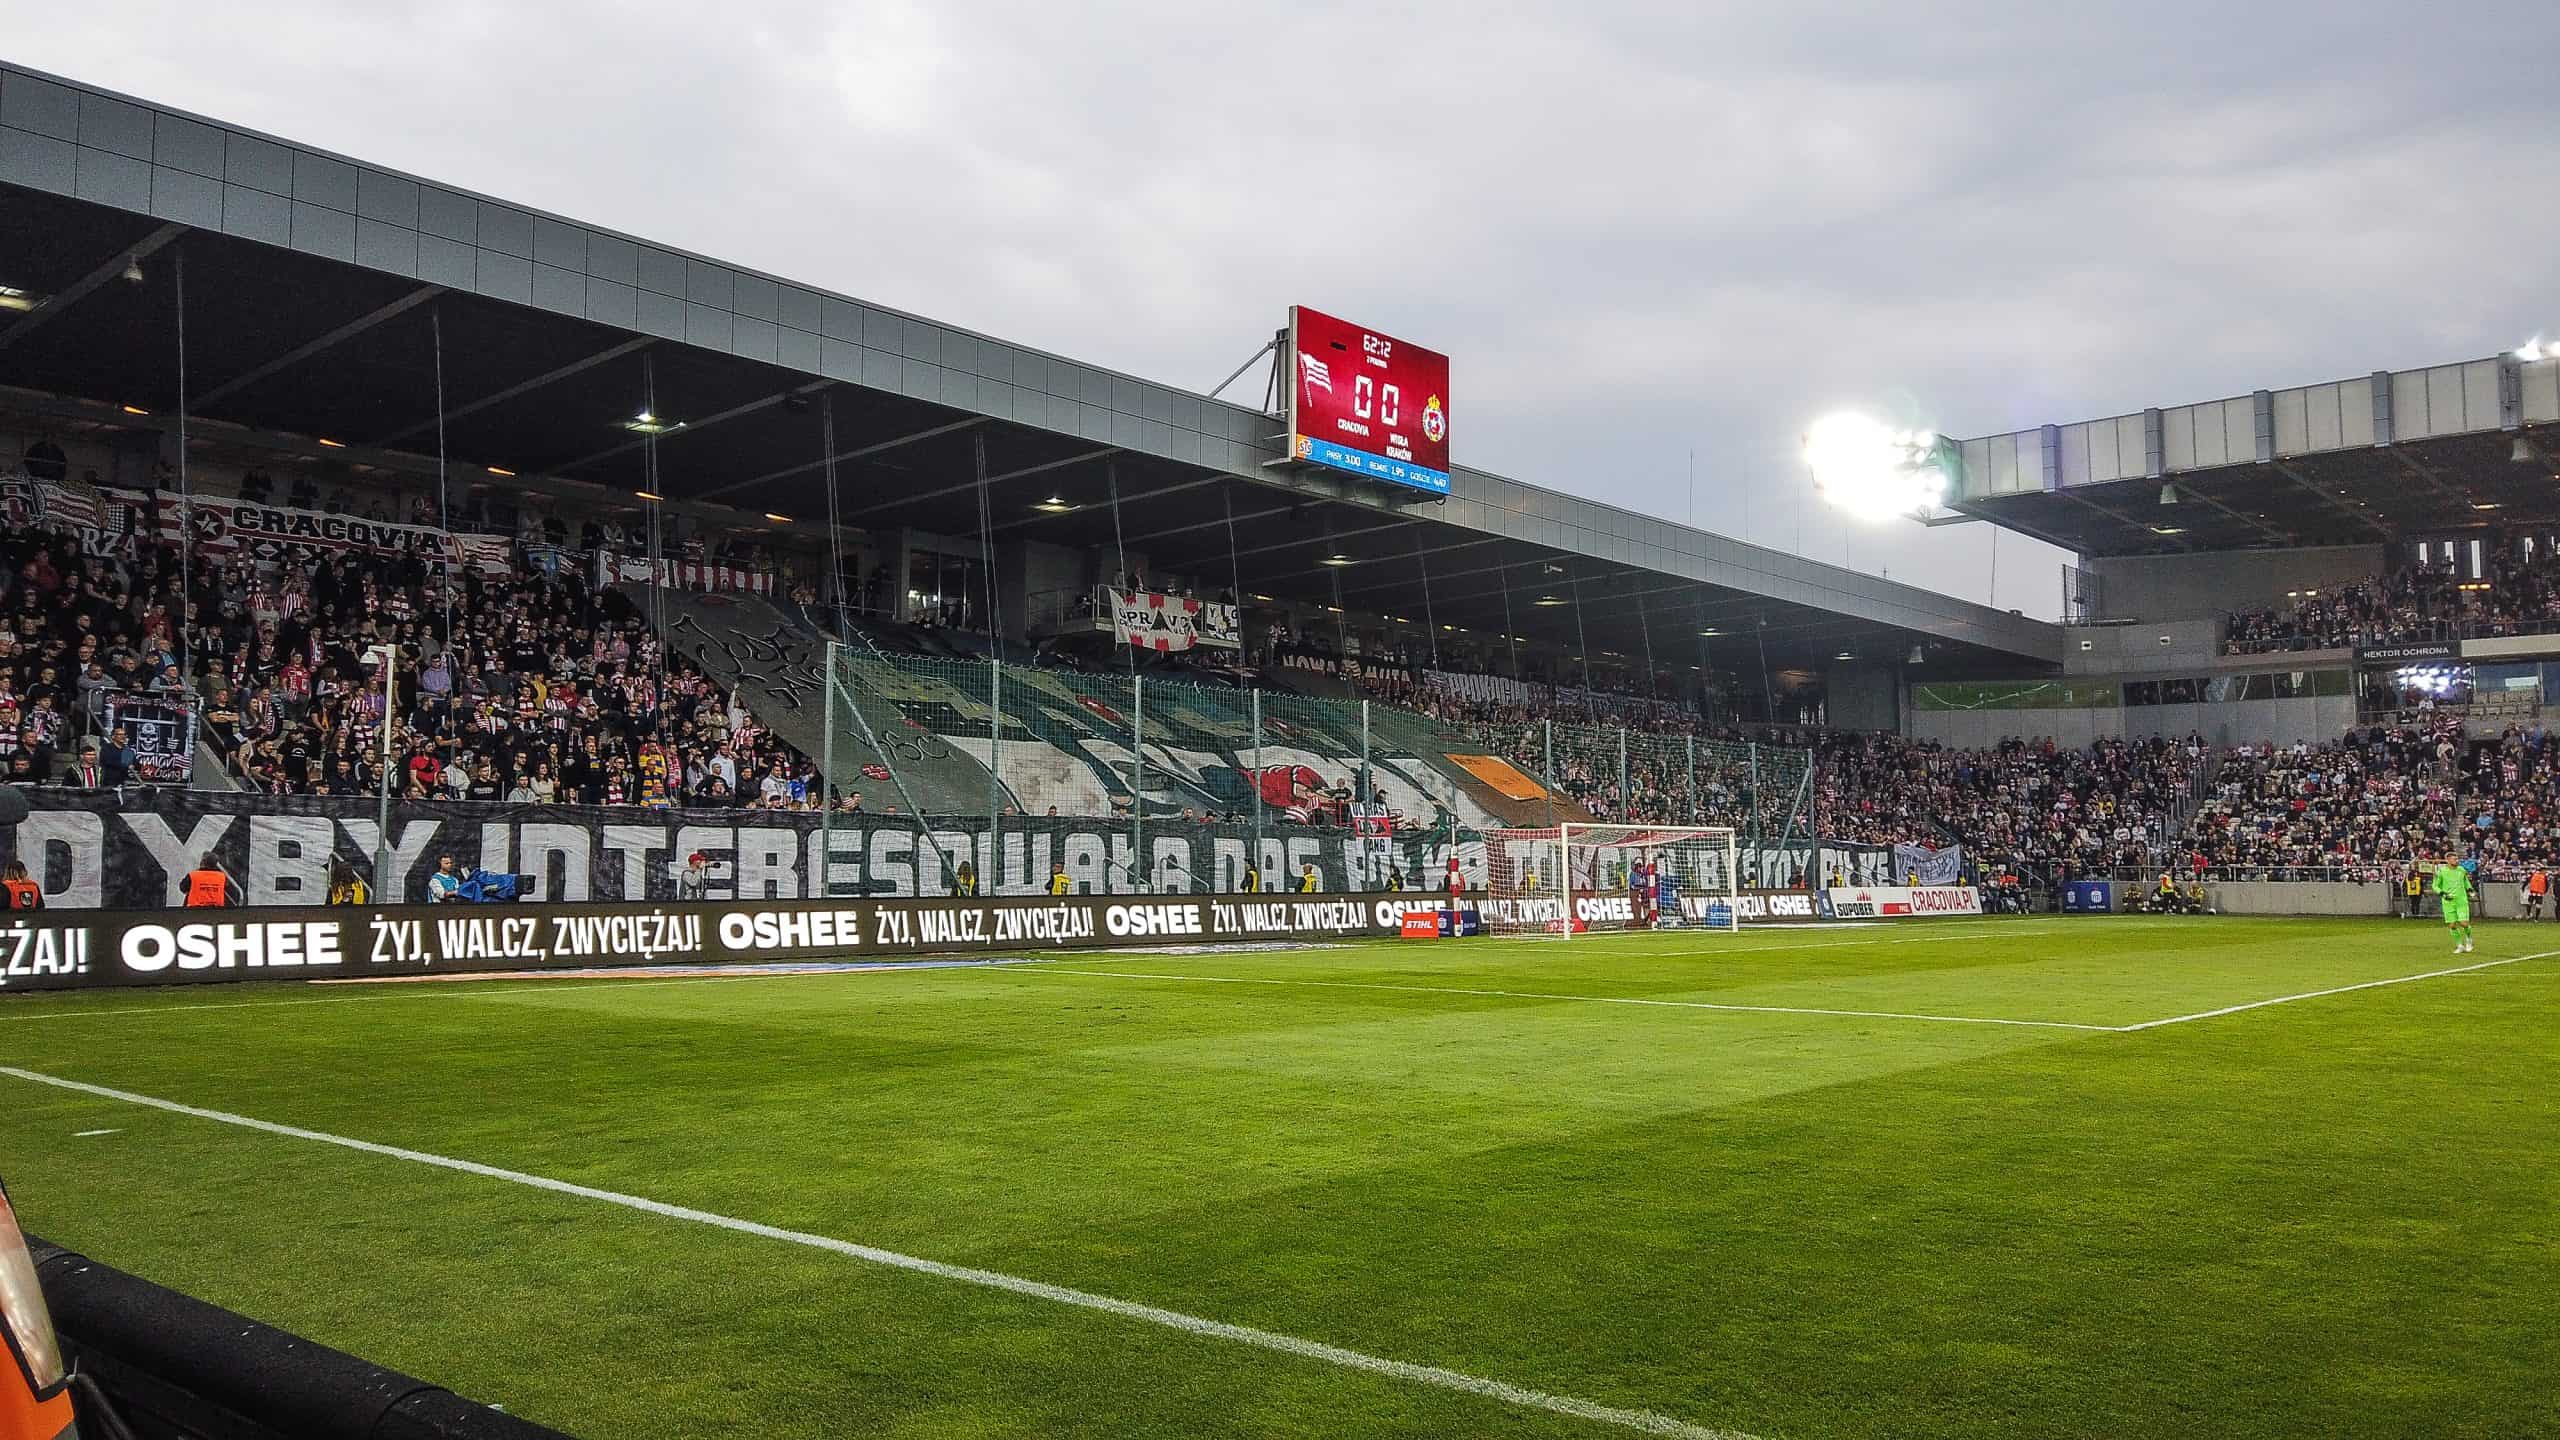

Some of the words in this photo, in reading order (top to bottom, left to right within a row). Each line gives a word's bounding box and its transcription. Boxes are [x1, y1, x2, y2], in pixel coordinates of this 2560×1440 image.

[1364, 334, 1391, 357] 62:12
[1355, 375, 1373, 419] 0
[1382, 385, 1399, 426] 0
[1338, 420, 1369, 436] CRACOVIA
[232, 506, 446, 556] CRACOVIA
[2364, 650, 2400, 659] HEKTOR
[2403, 648, 2448, 656] OCHRONA
[1351, 803, 1385, 816] ULRAS
[1362, 838, 1386, 853] ANG
[1214, 837, 1324, 894] NAS
[1576, 897, 1634, 922] OSHEE
[1770, 895, 1812, 915] OSHEE
[1912, 889, 1977, 913] CRACOVIA.PL
[719, 911, 859, 950] OSHEE
[875, 905, 916, 947] ŻYJ,
[918, 907, 991, 945] WALCZ,
[993, 901, 1095, 944] ZWYCIĘŻAJ!
[1106, 904, 1203, 936] OSHEE
[1211, 899, 1242, 936] ŻYJ,
[1241, 902, 1294, 935] WALCZ,
[1293, 897, 1369, 934] ZWYCIĘŻAJ!
[1406, 921, 1433, 929] STIHL
[121, 922, 342, 972] OSHEE
[370, 914, 432, 966] ŻYJ,
[438, 917, 546, 961] WALCZ,
[553, 909, 701, 960] ZWYCIĘŻAJ!
